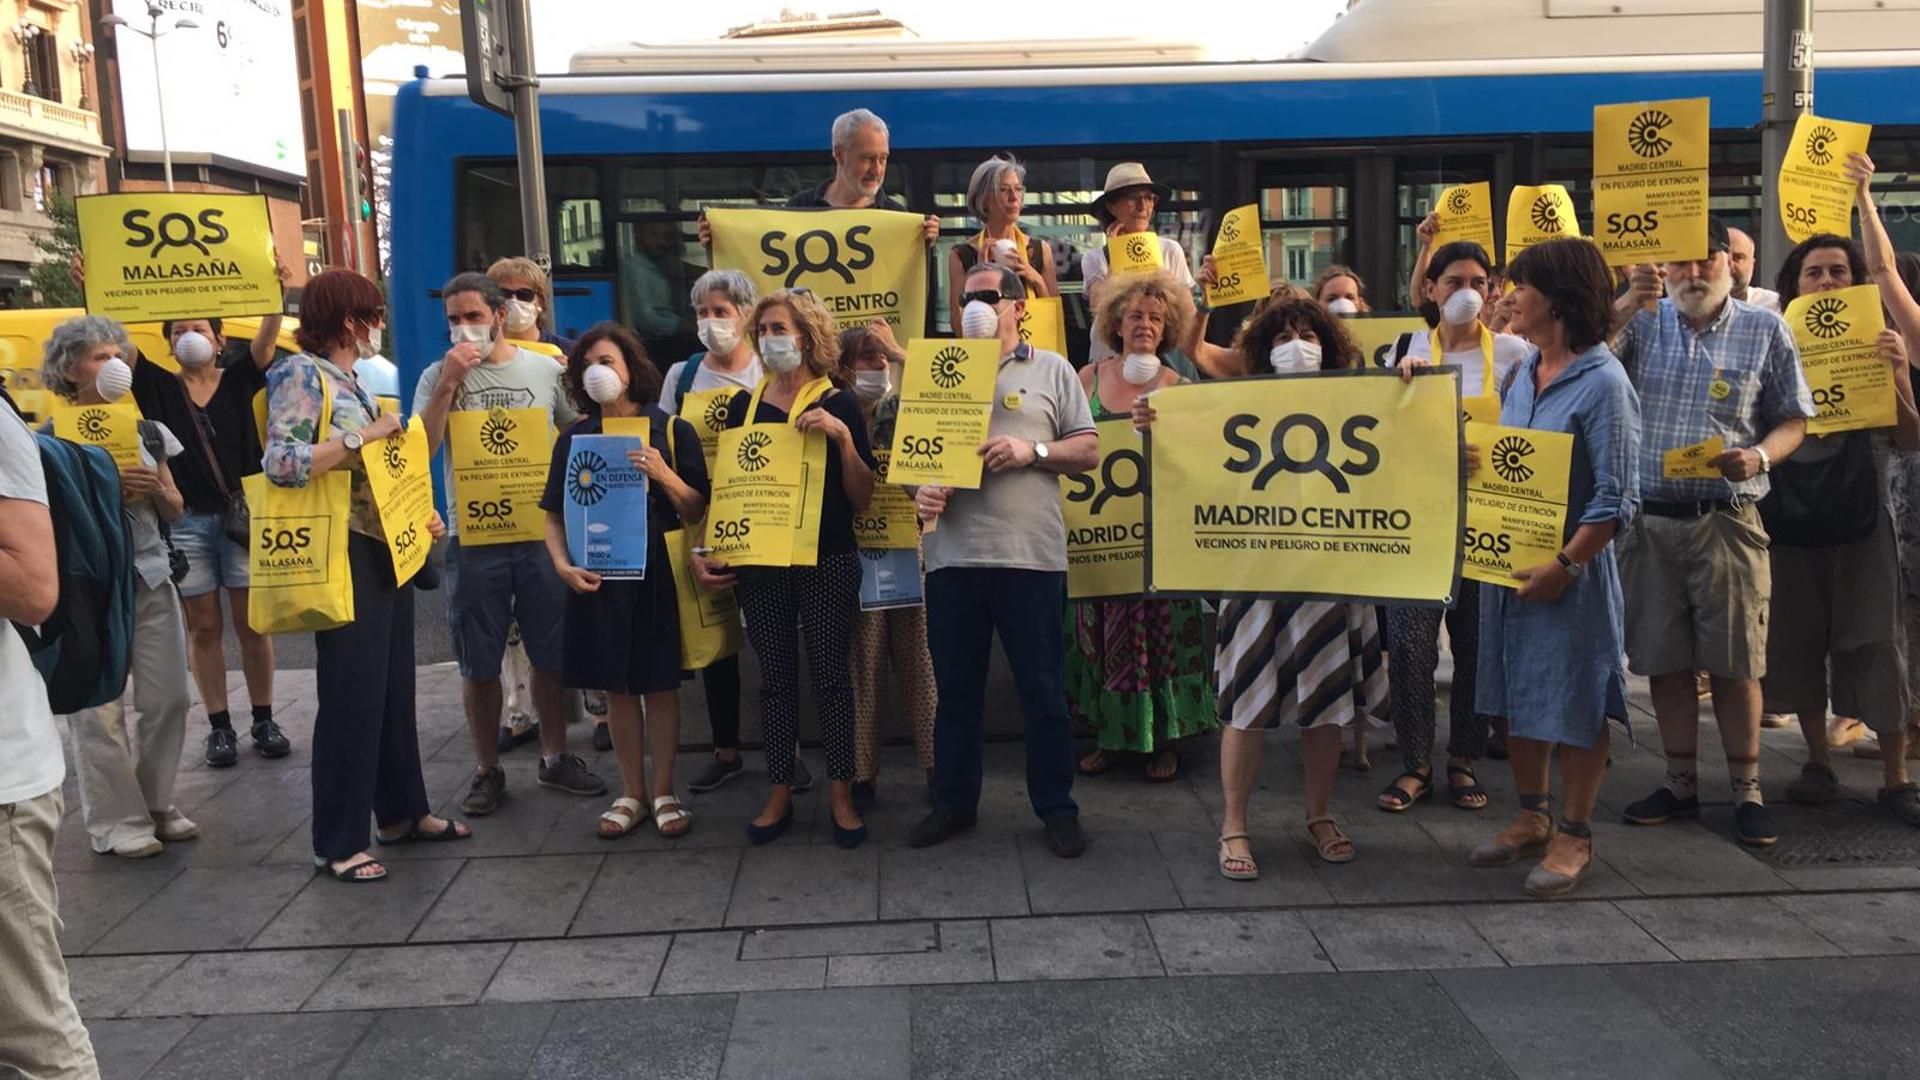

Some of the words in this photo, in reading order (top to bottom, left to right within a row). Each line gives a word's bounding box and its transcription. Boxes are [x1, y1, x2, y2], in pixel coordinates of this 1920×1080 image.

[1618, 162, 1648, 172] MADRID
[1649, 159, 1683, 170] CENTRAL
[1601, 182, 1611, 191] EN
[1612, 179, 1645, 190] PELIGRO
[1647, 178, 1657, 187] DE
[1786, 202, 1817, 228] SOS
[1607, 210, 1659, 239] SOS
[123, 209, 229, 258] SOS
[761, 225, 875, 288] SOS
[123, 258, 242, 280] MALASAÑA
[104, 288, 143, 298] VECINOS
[145, 287, 158, 296] EN
[160, 285, 195, 295] PELIGRO
[198, 285, 211, 293] DE
[1829, 338, 1863, 348] CENTRAL
[1830, 355, 1840, 364] DE
[943, 392, 972, 400] CENTRAL
[1812, 384, 1846, 409] OS
[913, 408, 940, 416] PELIGRO
[902, 435, 944, 460] SOS
[1223, 413, 1380, 493] SOS
[474, 458, 499, 466] MADRID
[500, 457, 530, 465] CENTRAL
[896, 460, 943, 471] MALASAÑA
[470, 472, 499, 481] PELIGRO
[500, 472, 509, 480] DE
[595, 473, 608, 481] EN
[609, 473, 643, 481] DEFENSA
[749, 474, 777, 483] CENTRAL
[746, 490, 754, 498] DE
[1482, 482, 1510, 494] MADRID
[1511, 485, 1544, 499] CENTRAL
[467, 498, 513, 523] SOS
[1475, 496, 1506, 510] PELIGRO
[1506, 502, 1518, 511] DE
[1518, 503, 1557, 518] EXTINCIÓN
[466, 519, 517, 532] MALASAÑA
[854, 516, 887, 533] SOS
[1194, 505, 1297, 527] MADRID
[1302, 507, 1411, 531] CENTRO
[395, 522, 417, 556] SOS
[714, 518, 751, 543] SOS
[1067, 524, 1127, 546] ADRID
[261, 527, 311, 556] SOS
[1195, 538, 1247, 550] VECINOS
[1250, 539, 1267, 550] EN
[1270, 539, 1321, 551] PELIGRO
[1324, 541, 1340, 552] DE
[1343, 541, 1411, 555] EXTINCIÓN
[1464, 527, 1511, 558] SOS
[1093, 552, 1106, 563] EN
